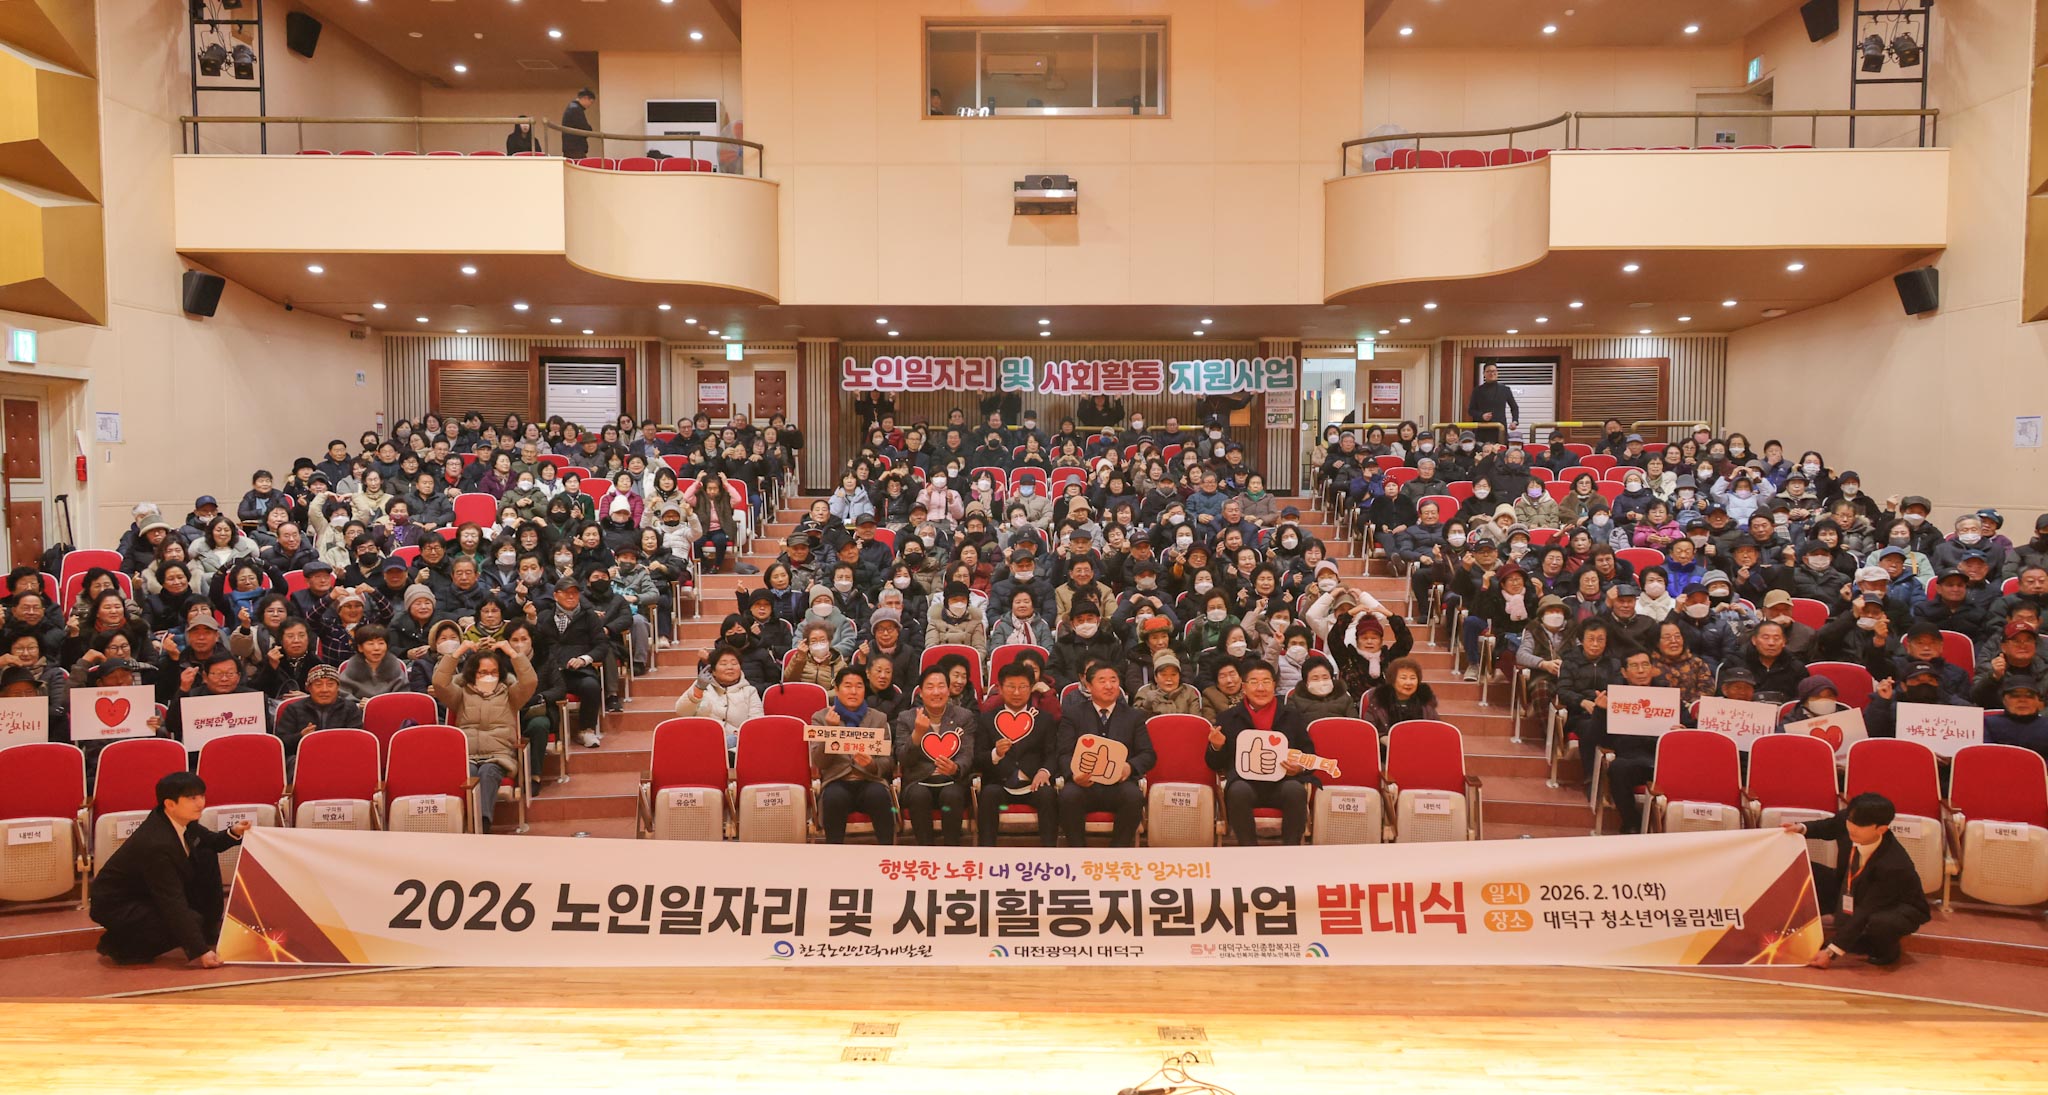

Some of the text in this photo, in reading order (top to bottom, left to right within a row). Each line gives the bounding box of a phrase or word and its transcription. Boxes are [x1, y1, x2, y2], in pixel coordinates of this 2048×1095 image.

[844, 358, 1295, 392] 노인일자리 및 사회활동 지원사업
[1611, 701, 1675, 719] 행복한 일자리
[194, 715, 258, 729] 행복한 일자리
[817, 729, 876, 740] 오늘도 존재만으로
[322, 813, 345, 821] 박효서
[878, 859, 1212, 883] 행복한 노후! 내 일상이, 행복한 일자리!
[1488, 882, 1667, 904] 일시 2026. 2. 10.(화)
[388, 879, 1468, 938] 2026 노인일자리 및 사회활동지원사업 발대식
[1490, 907, 1743, 931] 장소 대덕구 청소년어울림센터
[799, 943, 934, 959] 한국노인인력개발원
[1014, 945, 1145, 959] 대전광역시 대덕구
[1218, 942, 1301, 952] 대덕구노인종합복지관
